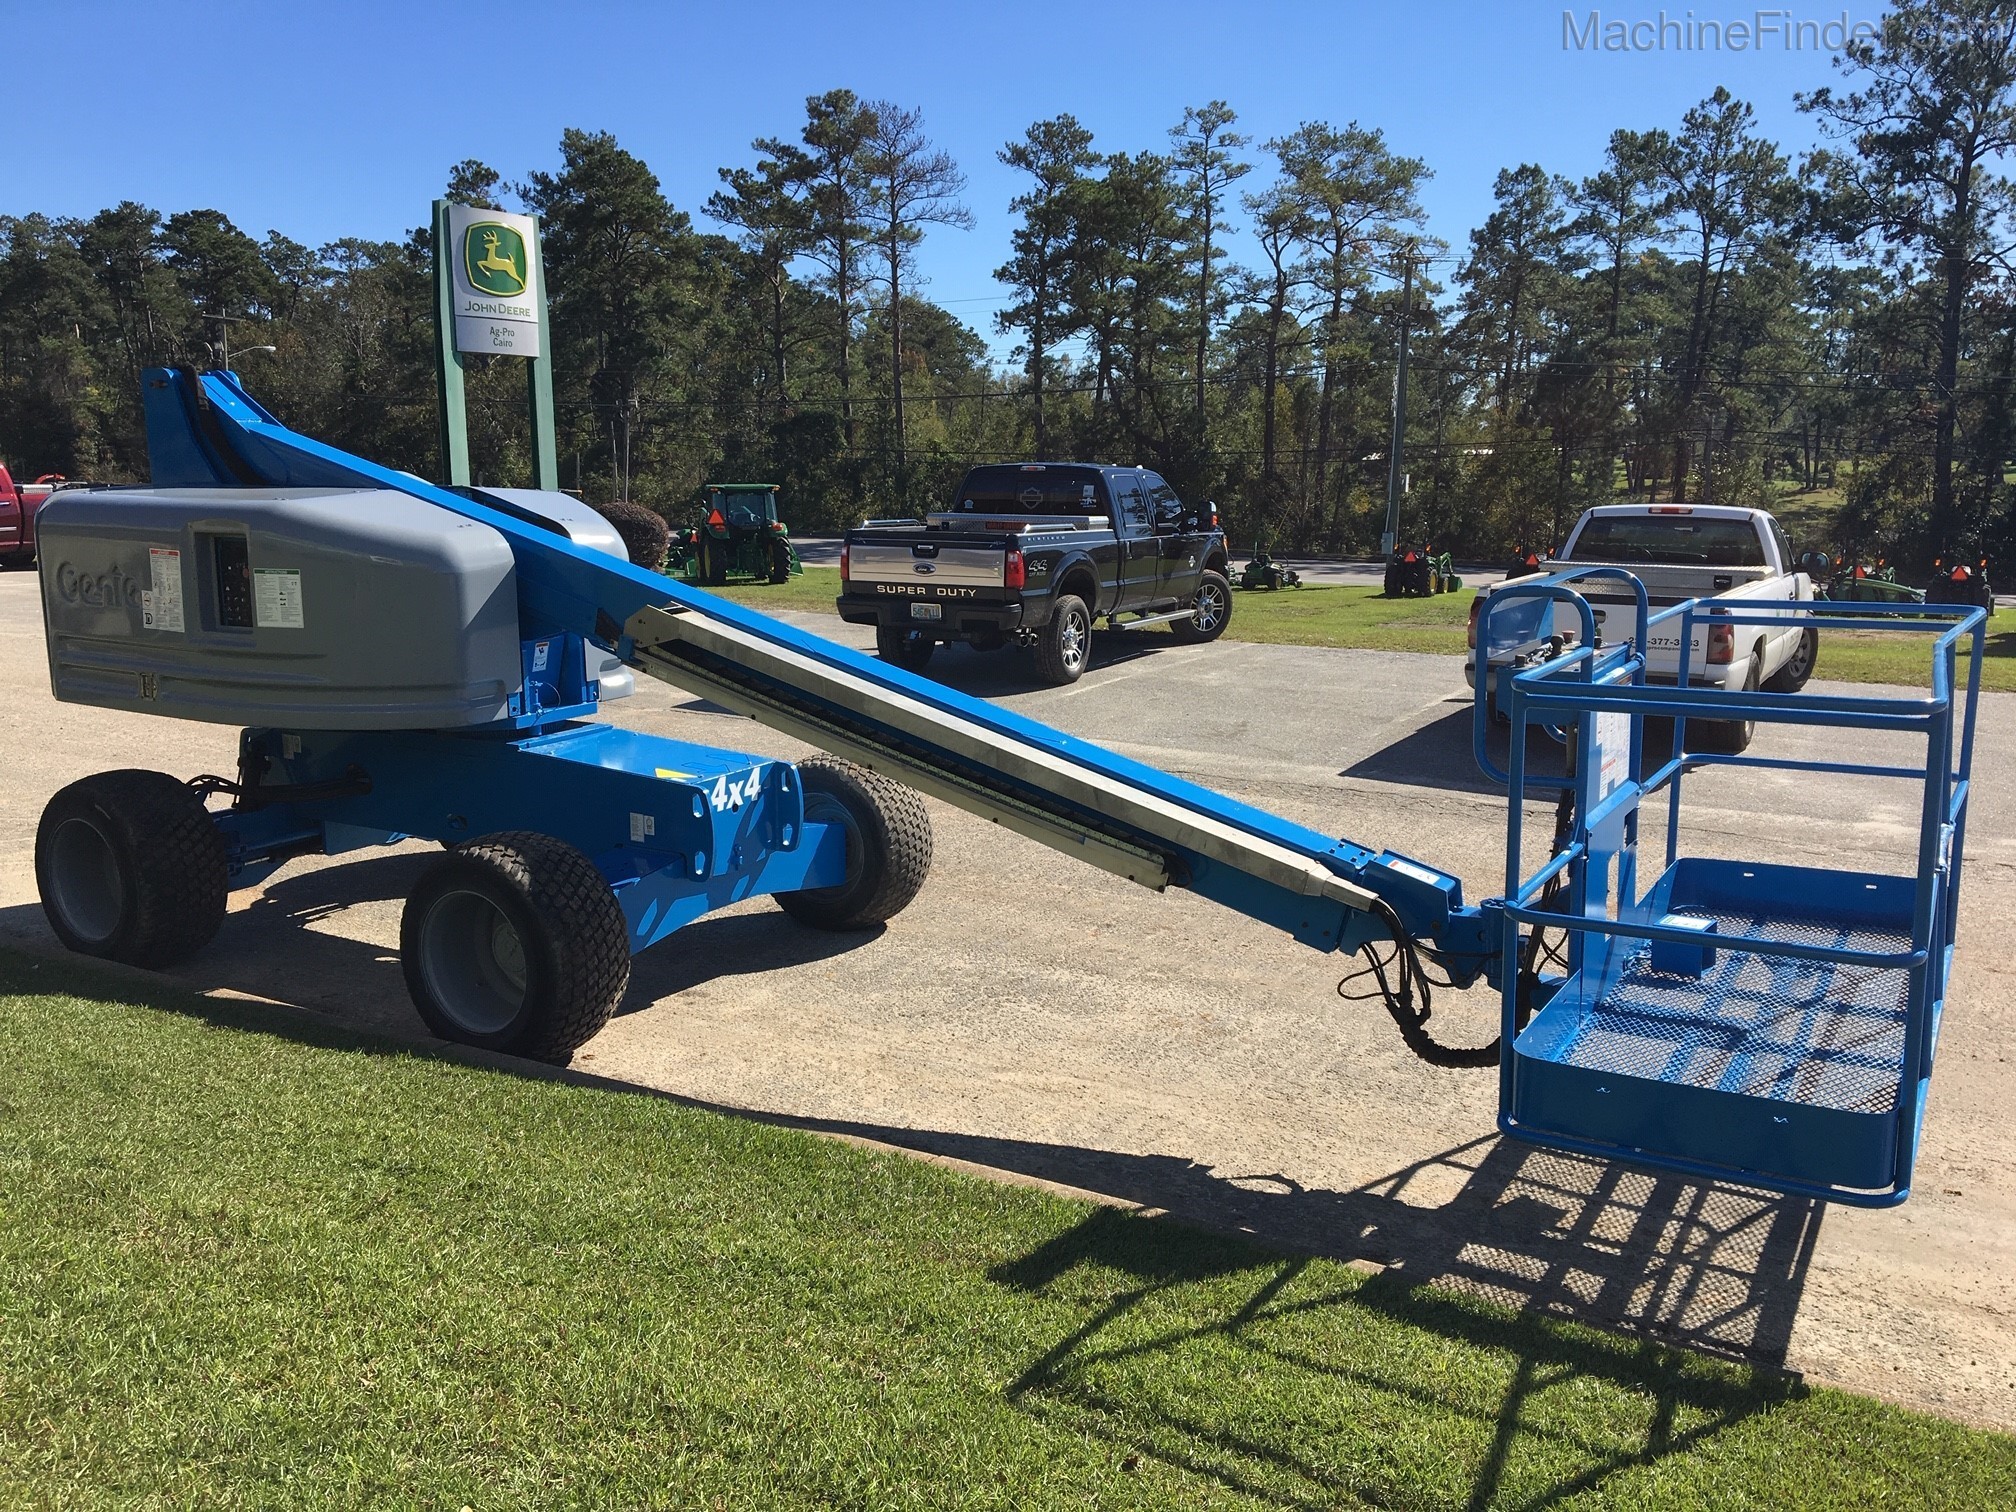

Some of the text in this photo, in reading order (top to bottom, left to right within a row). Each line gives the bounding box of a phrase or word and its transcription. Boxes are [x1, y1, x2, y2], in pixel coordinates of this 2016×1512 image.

[465, 301, 530, 316] JOHN DEERE
[489, 326, 515, 337] Ag-Pro
[493, 337, 513, 347] Cairo
[56, 560, 142, 607] Genie
[876, 585, 977, 597] SUPER DUTY
[1628, 636, 1700, 647] 2-377-33
[711, 767, 762, 811] 4x4
